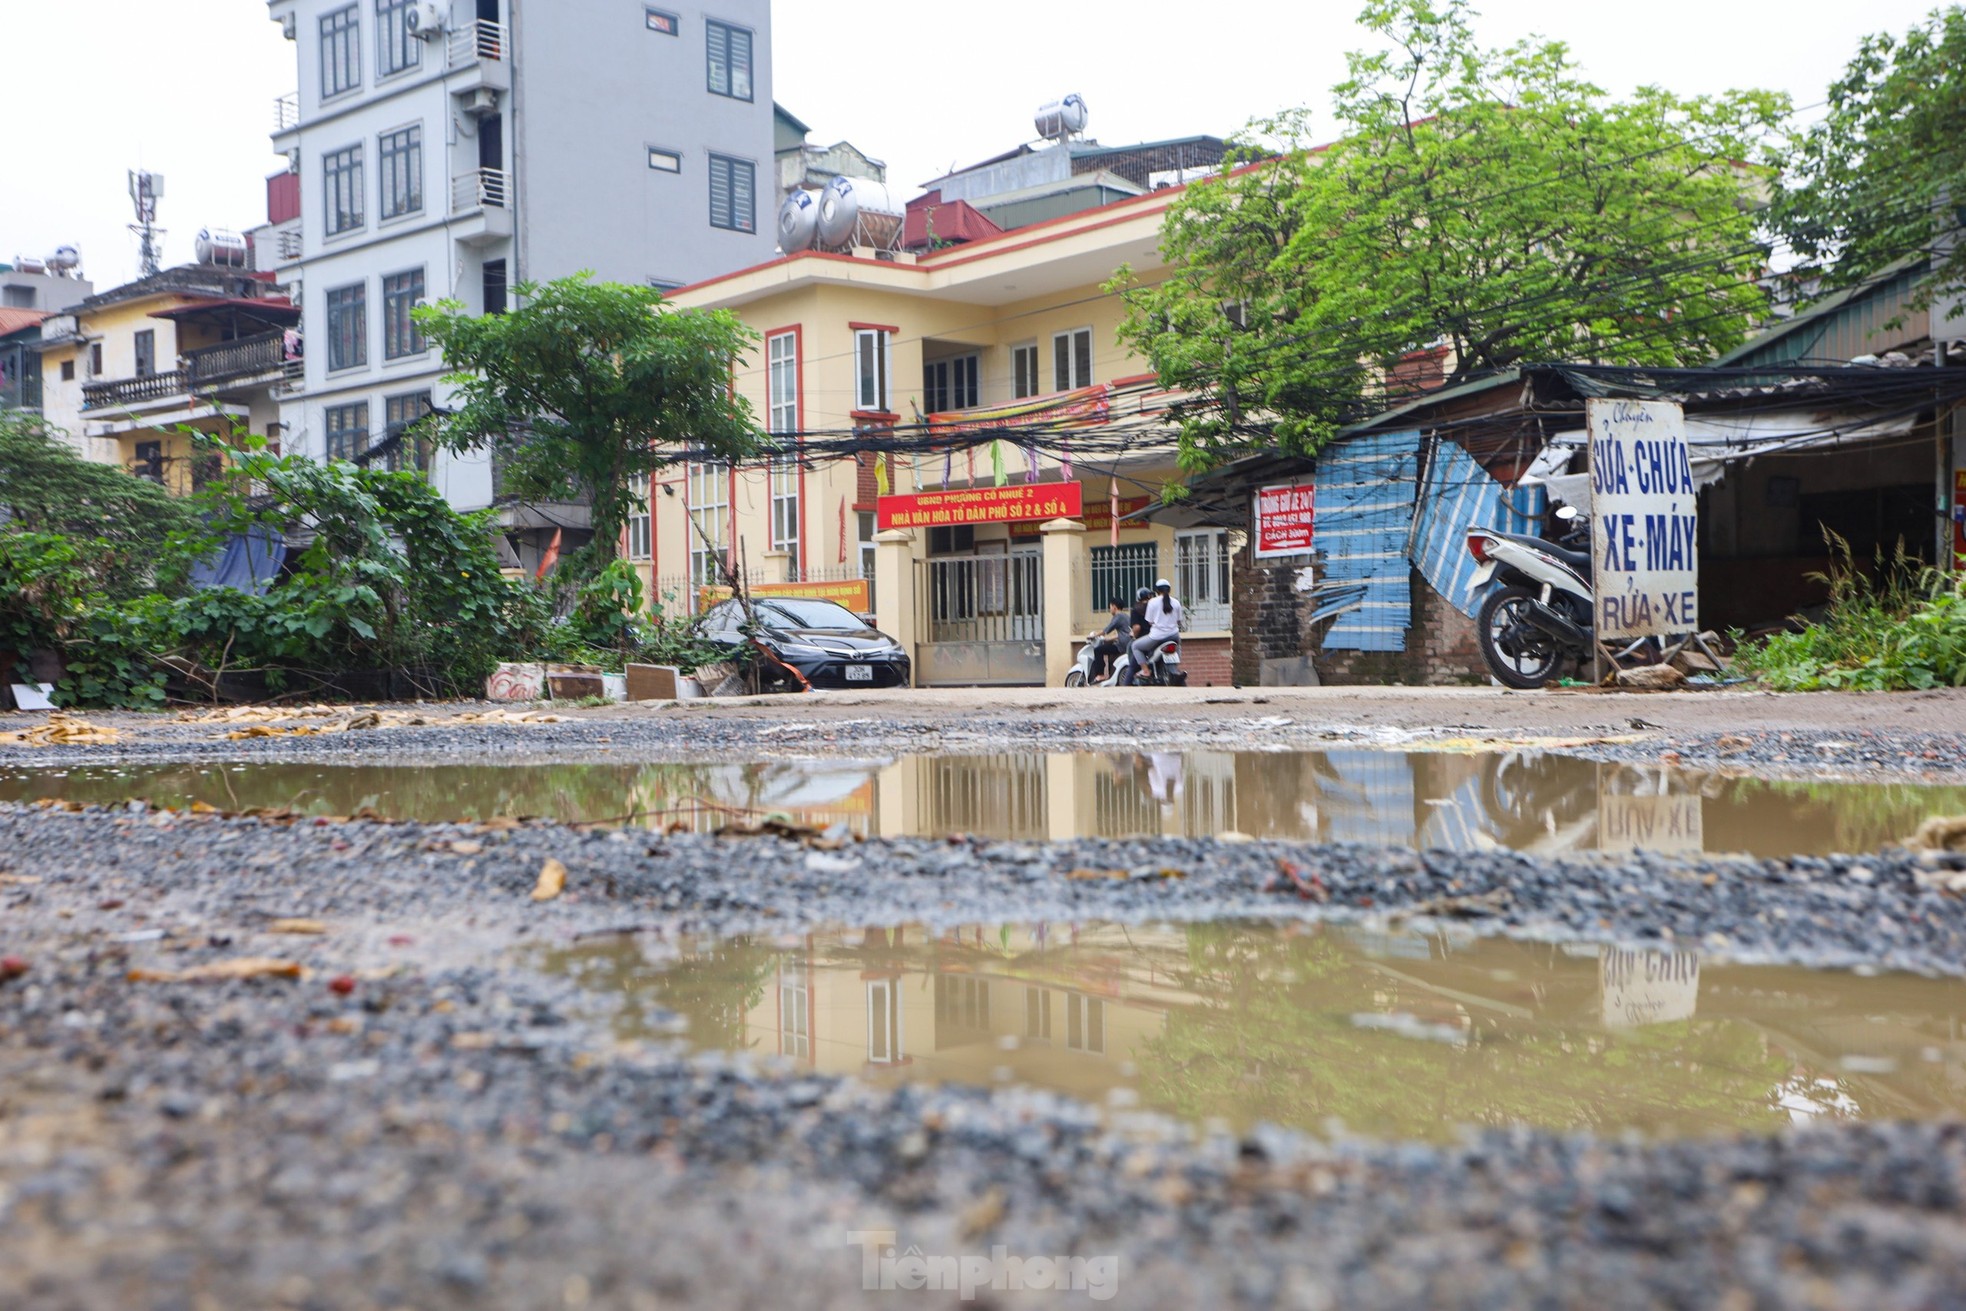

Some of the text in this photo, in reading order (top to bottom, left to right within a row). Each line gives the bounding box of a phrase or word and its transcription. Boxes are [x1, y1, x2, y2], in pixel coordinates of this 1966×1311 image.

[917, 497, 942, 506] UBND
[944, 491, 982, 504] PHƯỜNG
[1026, 489, 1034, 498] 2
[891, 509, 910, 525] NHÀ
[913, 509, 930, 524] VĂN
[966, 505, 986, 520] DÂN
[1025, 504, 1032, 517] 2
[1034, 504, 1042, 516] &
[1060, 502, 1067, 514] 4
[1602, 502, 1696, 572] XE MÁY
[1662, 591, 1695, 625] XE
